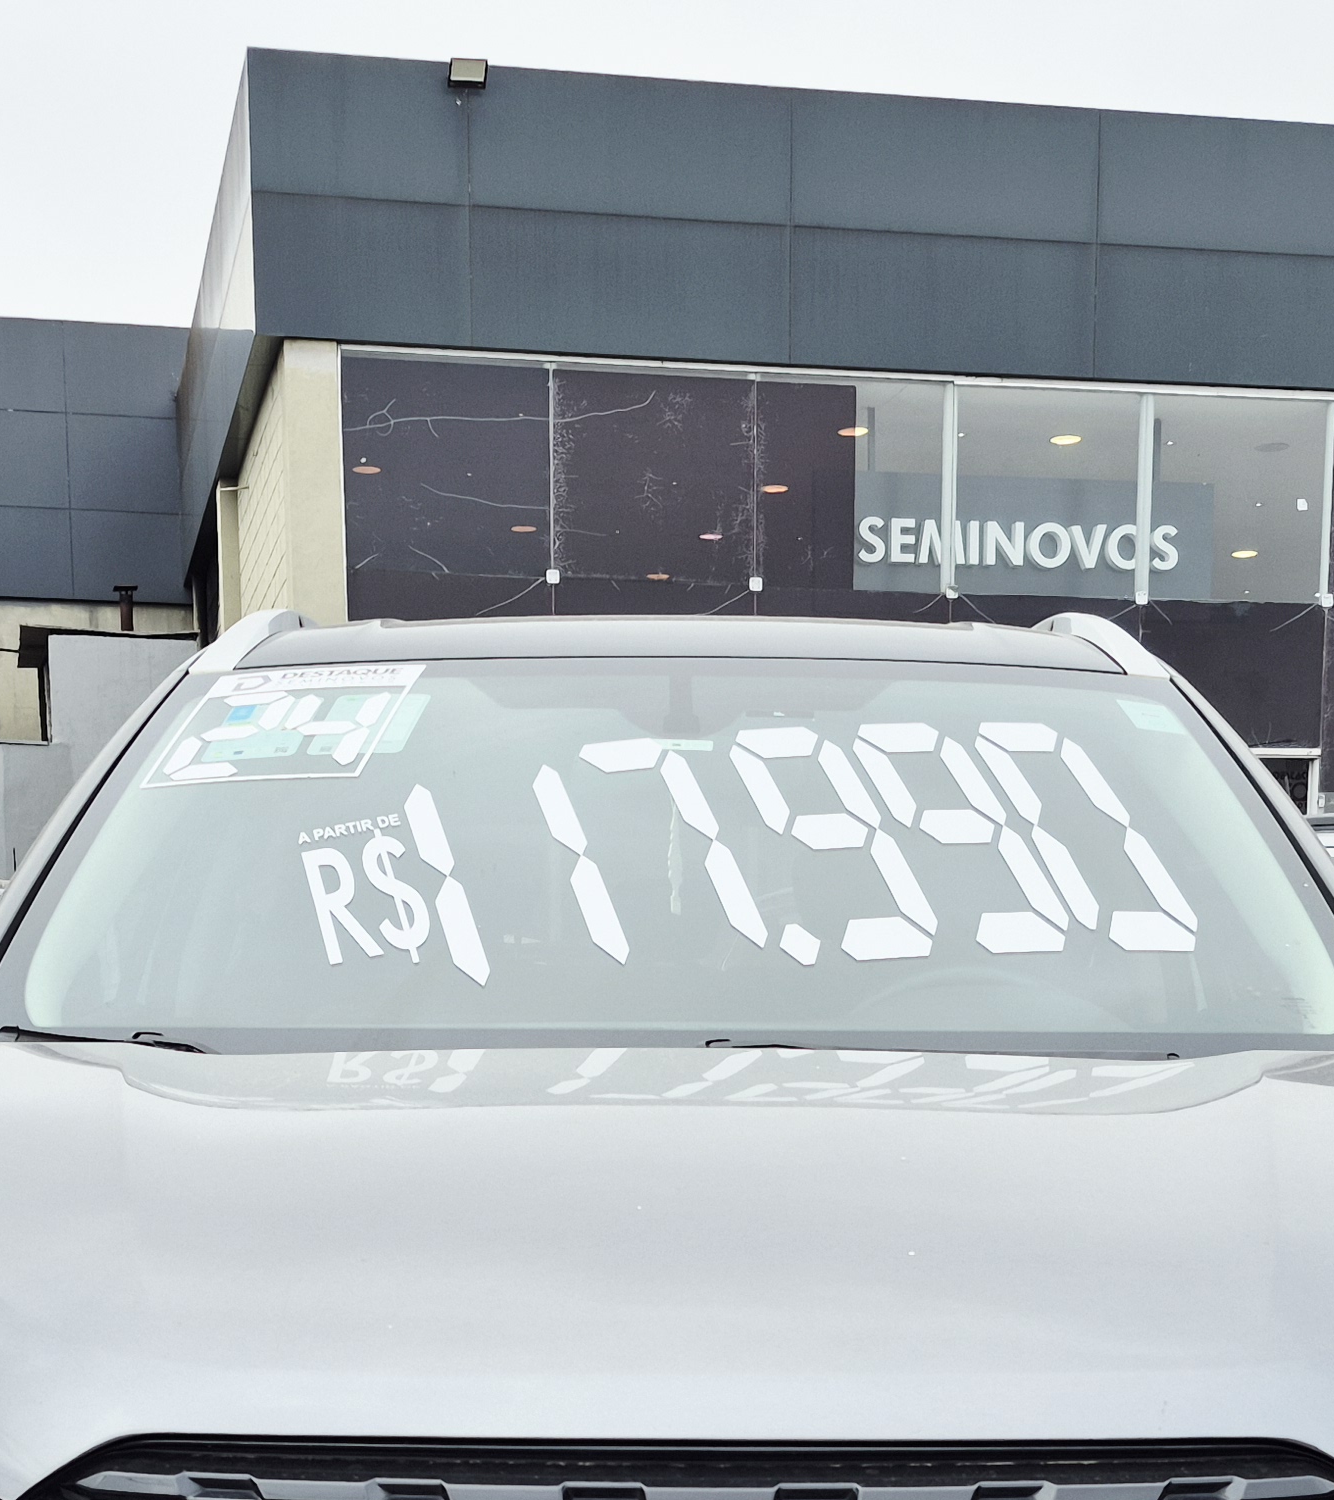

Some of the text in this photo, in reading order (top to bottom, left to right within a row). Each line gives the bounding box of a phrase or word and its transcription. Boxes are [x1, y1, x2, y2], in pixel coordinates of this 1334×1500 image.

[857, 516, 1179, 571] SEMINOVOS
[281, 667, 403, 680] DESTAQUE
[163, 691, 392, 781] 24
[298, 813, 401, 845] A PARTIR DE
